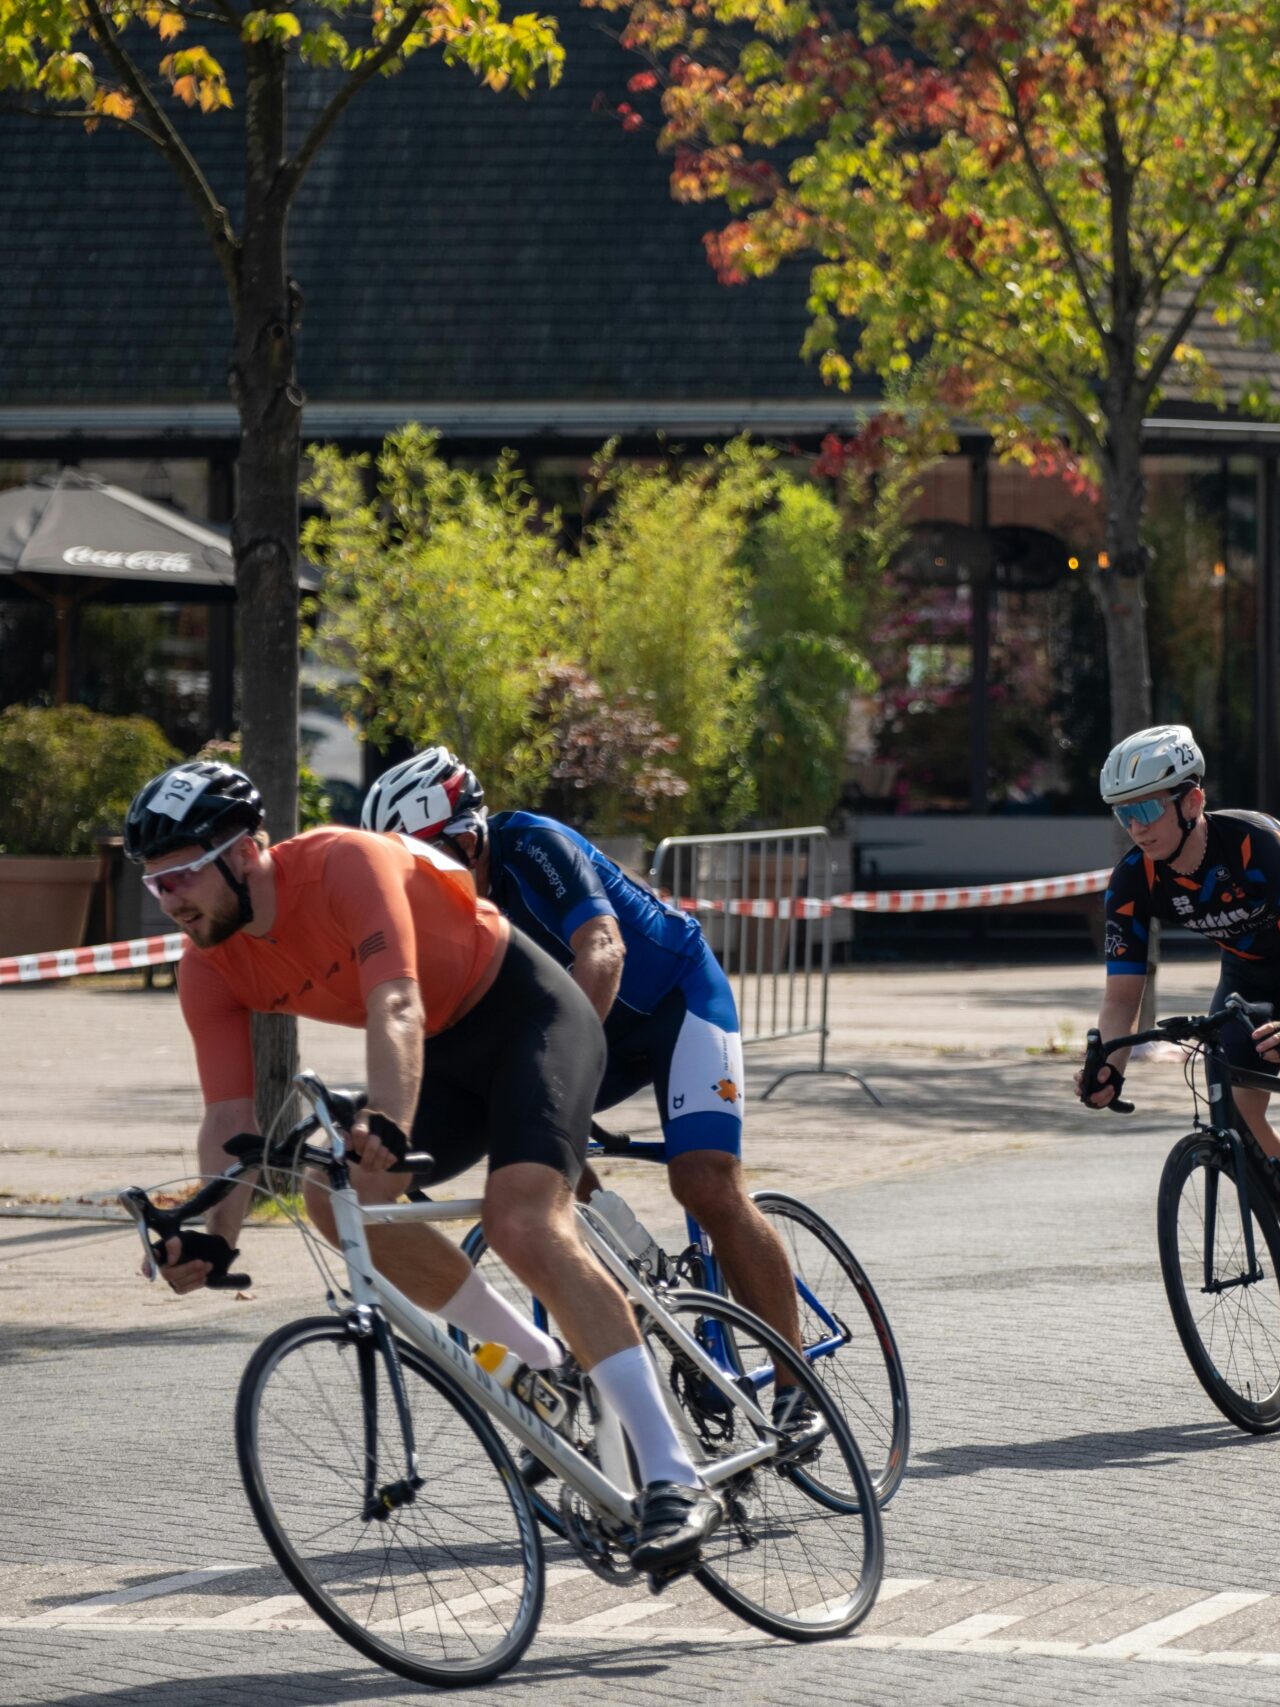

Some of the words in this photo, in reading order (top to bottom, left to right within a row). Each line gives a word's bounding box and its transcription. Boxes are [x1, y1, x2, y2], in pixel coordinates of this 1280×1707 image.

[1175, 743, 1195, 766] 23
[164, 779, 194, 802] 19
[416, 796, 430, 819] 7
